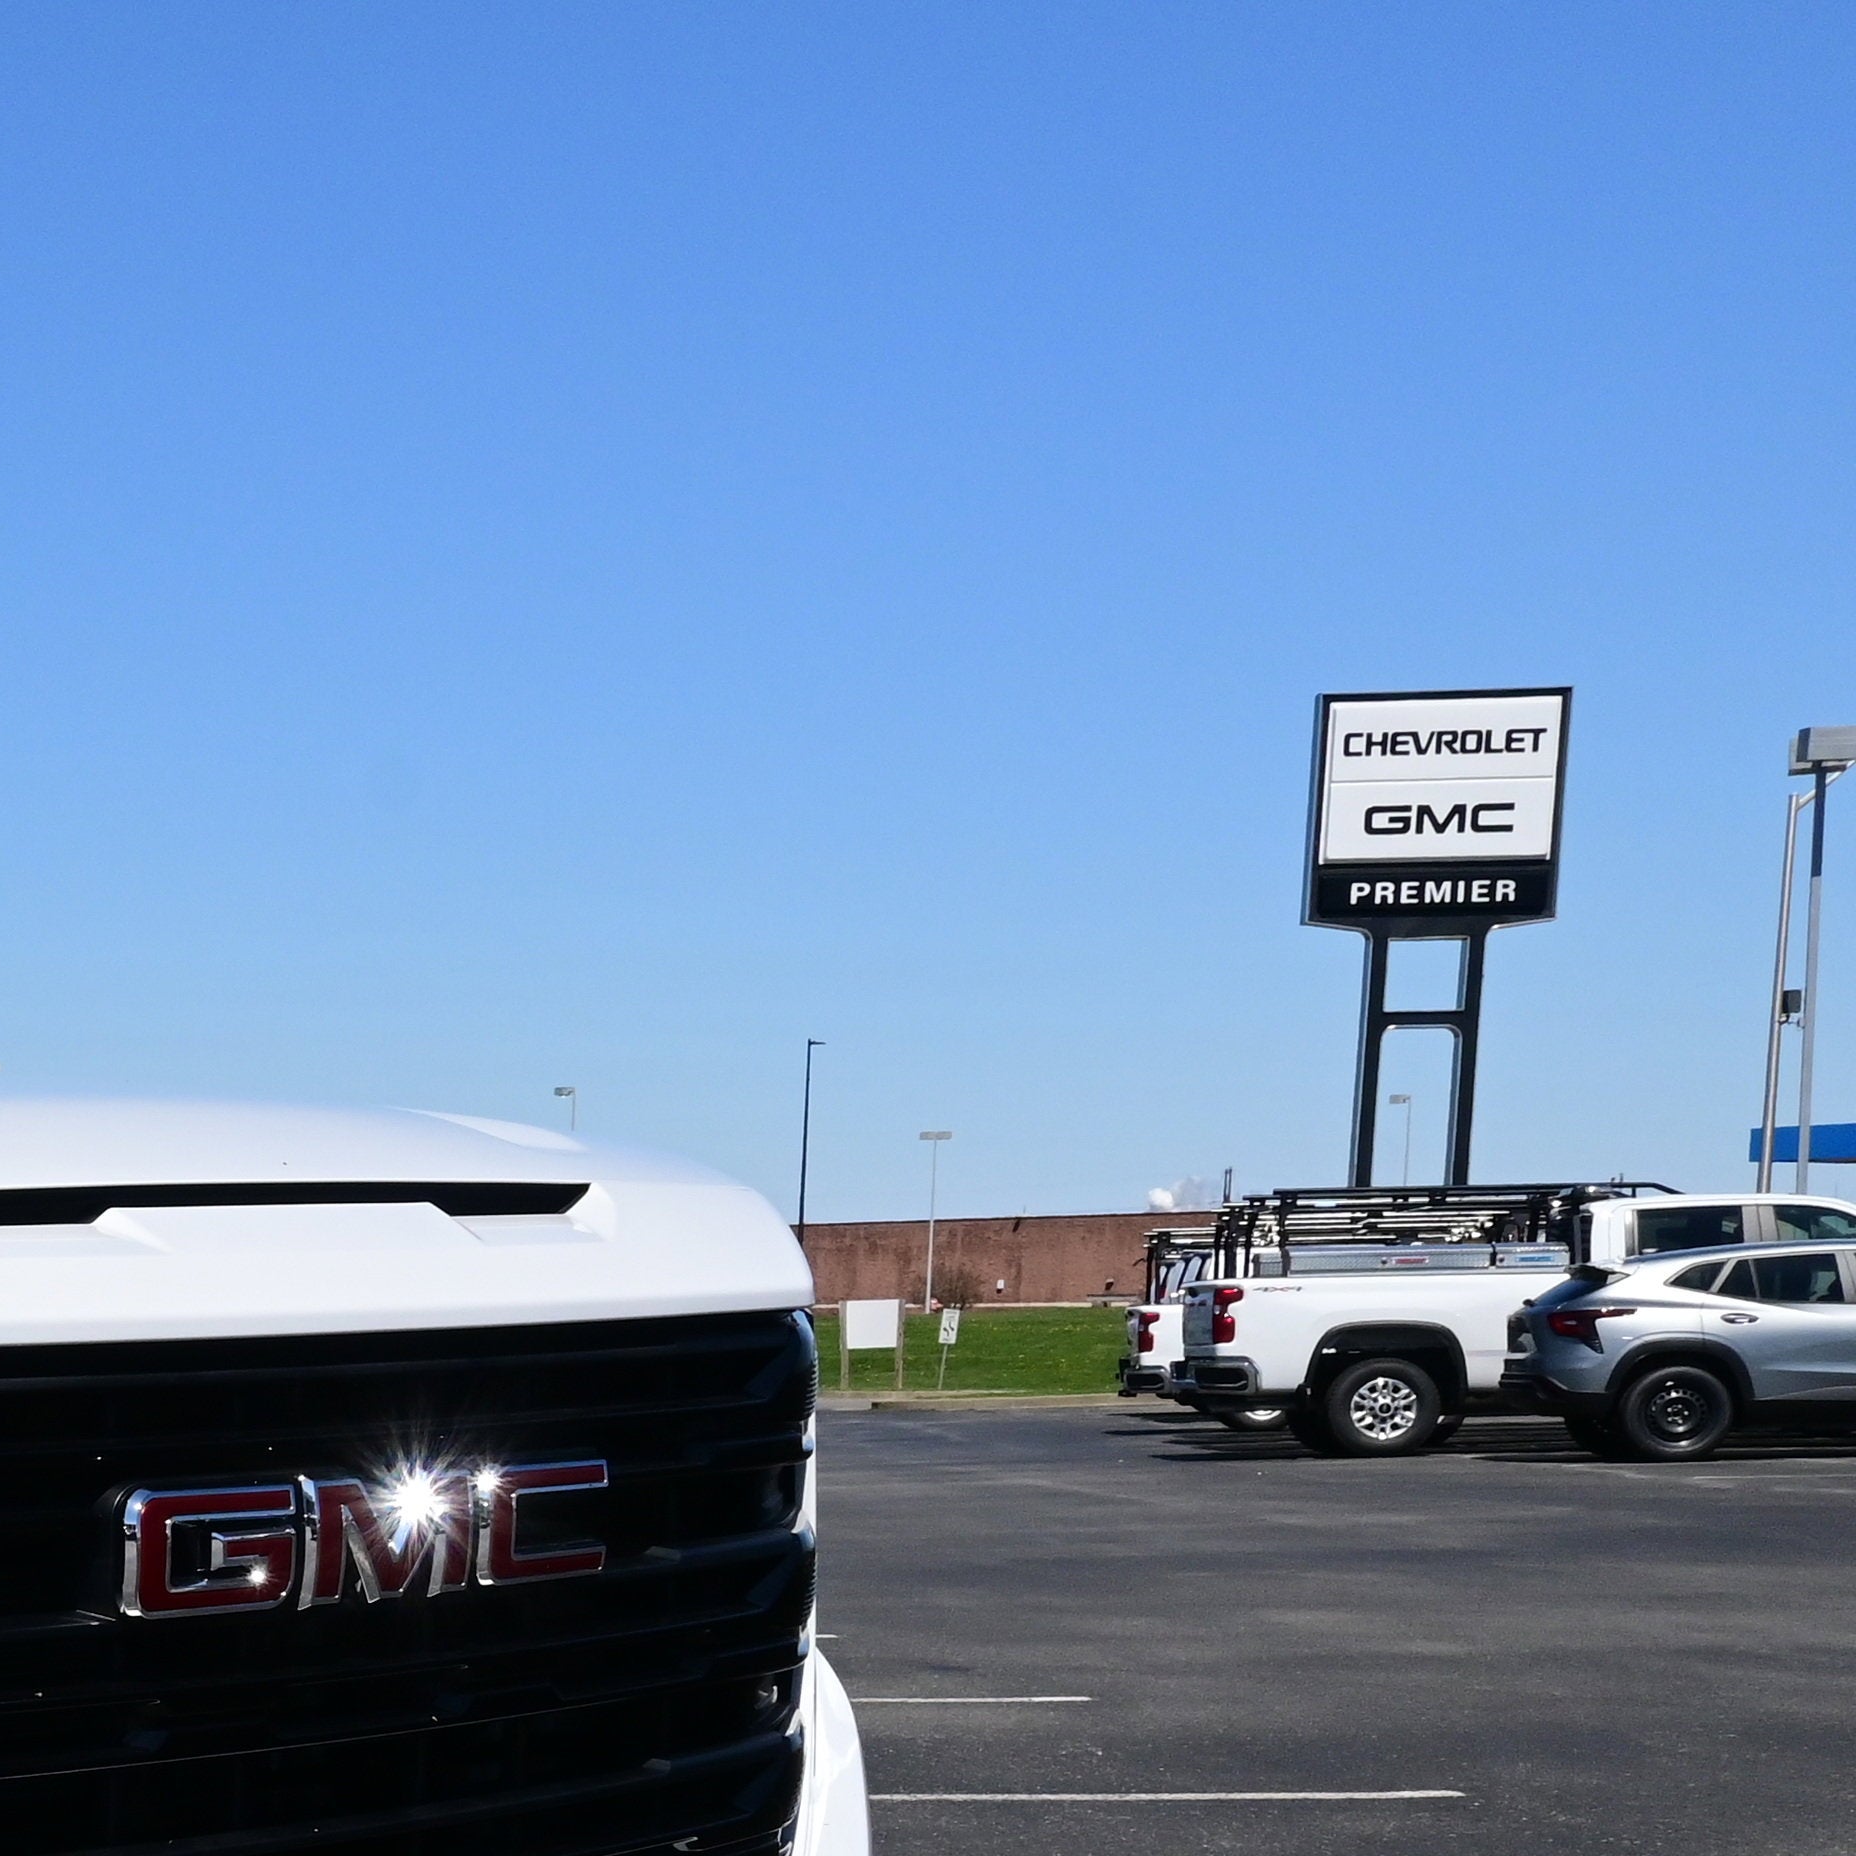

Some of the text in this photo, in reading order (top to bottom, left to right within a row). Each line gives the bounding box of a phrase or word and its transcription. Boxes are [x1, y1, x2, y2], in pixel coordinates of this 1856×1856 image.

[1342, 727, 1548, 758] CHEVROLET
[1363, 801, 1516, 836] GMC
[1349, 879, 1517, 906] PREMIER
[119, 1458, 610, 1620] GMC
